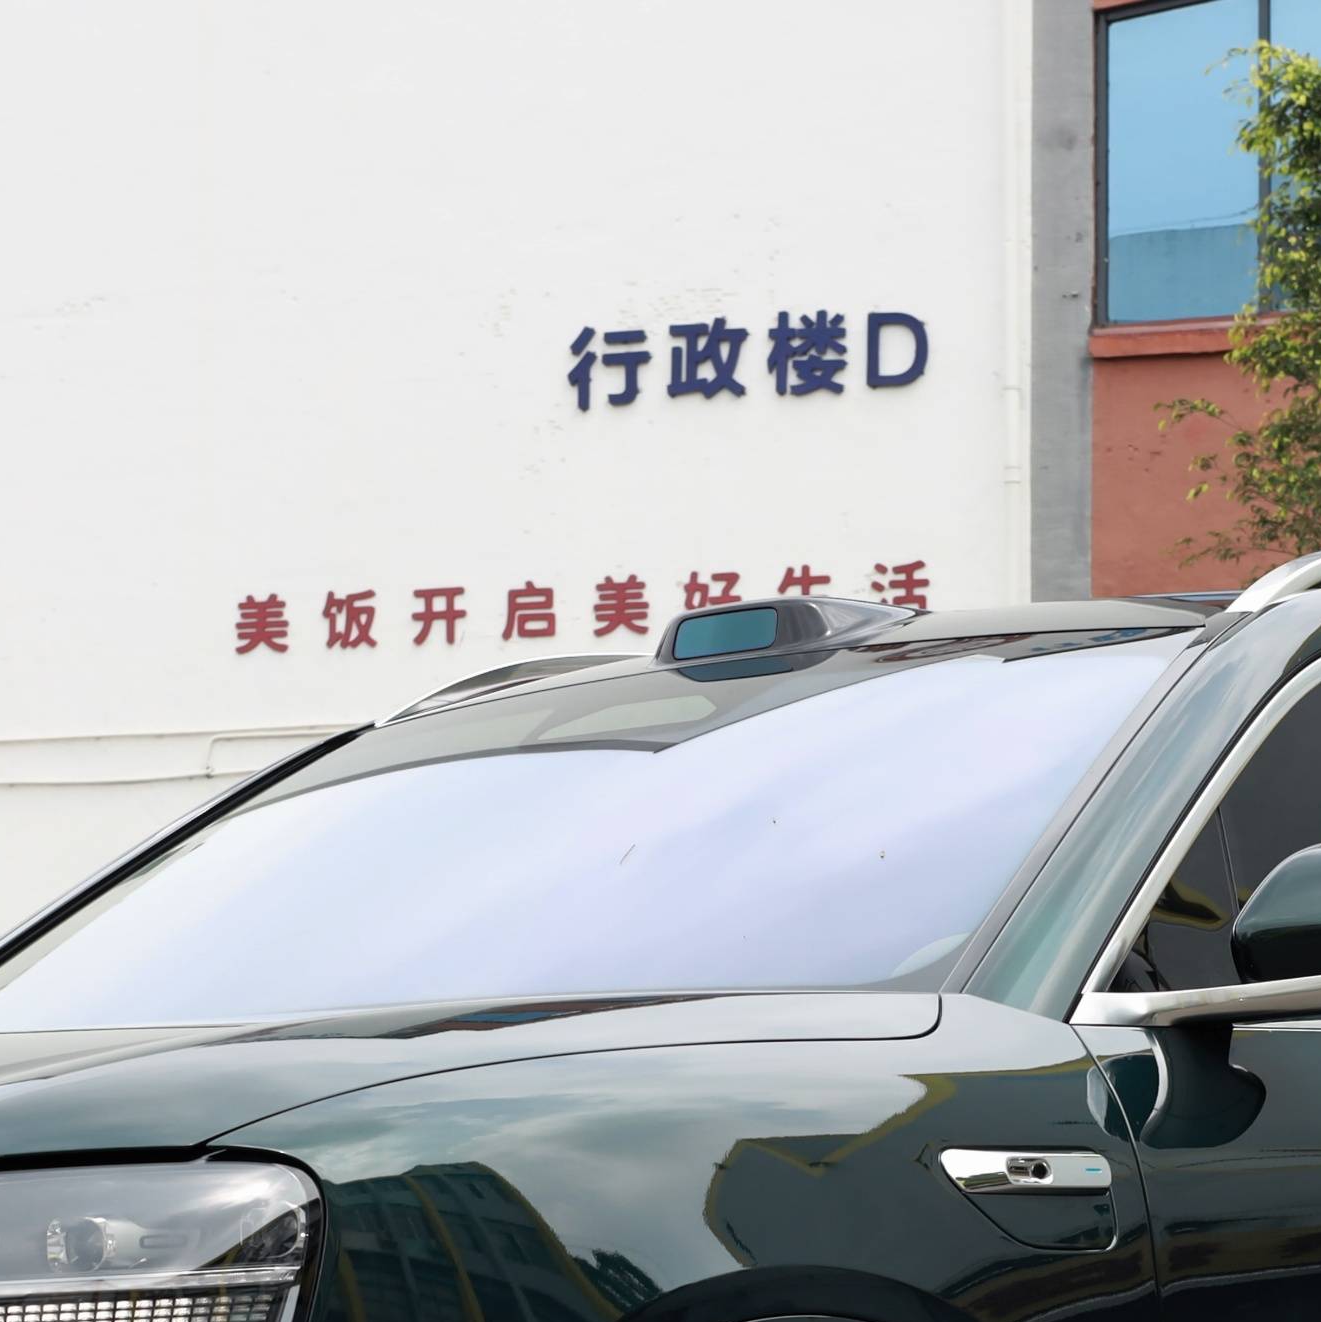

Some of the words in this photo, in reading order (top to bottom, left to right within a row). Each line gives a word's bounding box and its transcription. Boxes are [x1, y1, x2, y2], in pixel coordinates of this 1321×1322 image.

[568, 310, 929, 412] 行政楼D
[235, 560, 930, 654] 美饭开启美好生活
